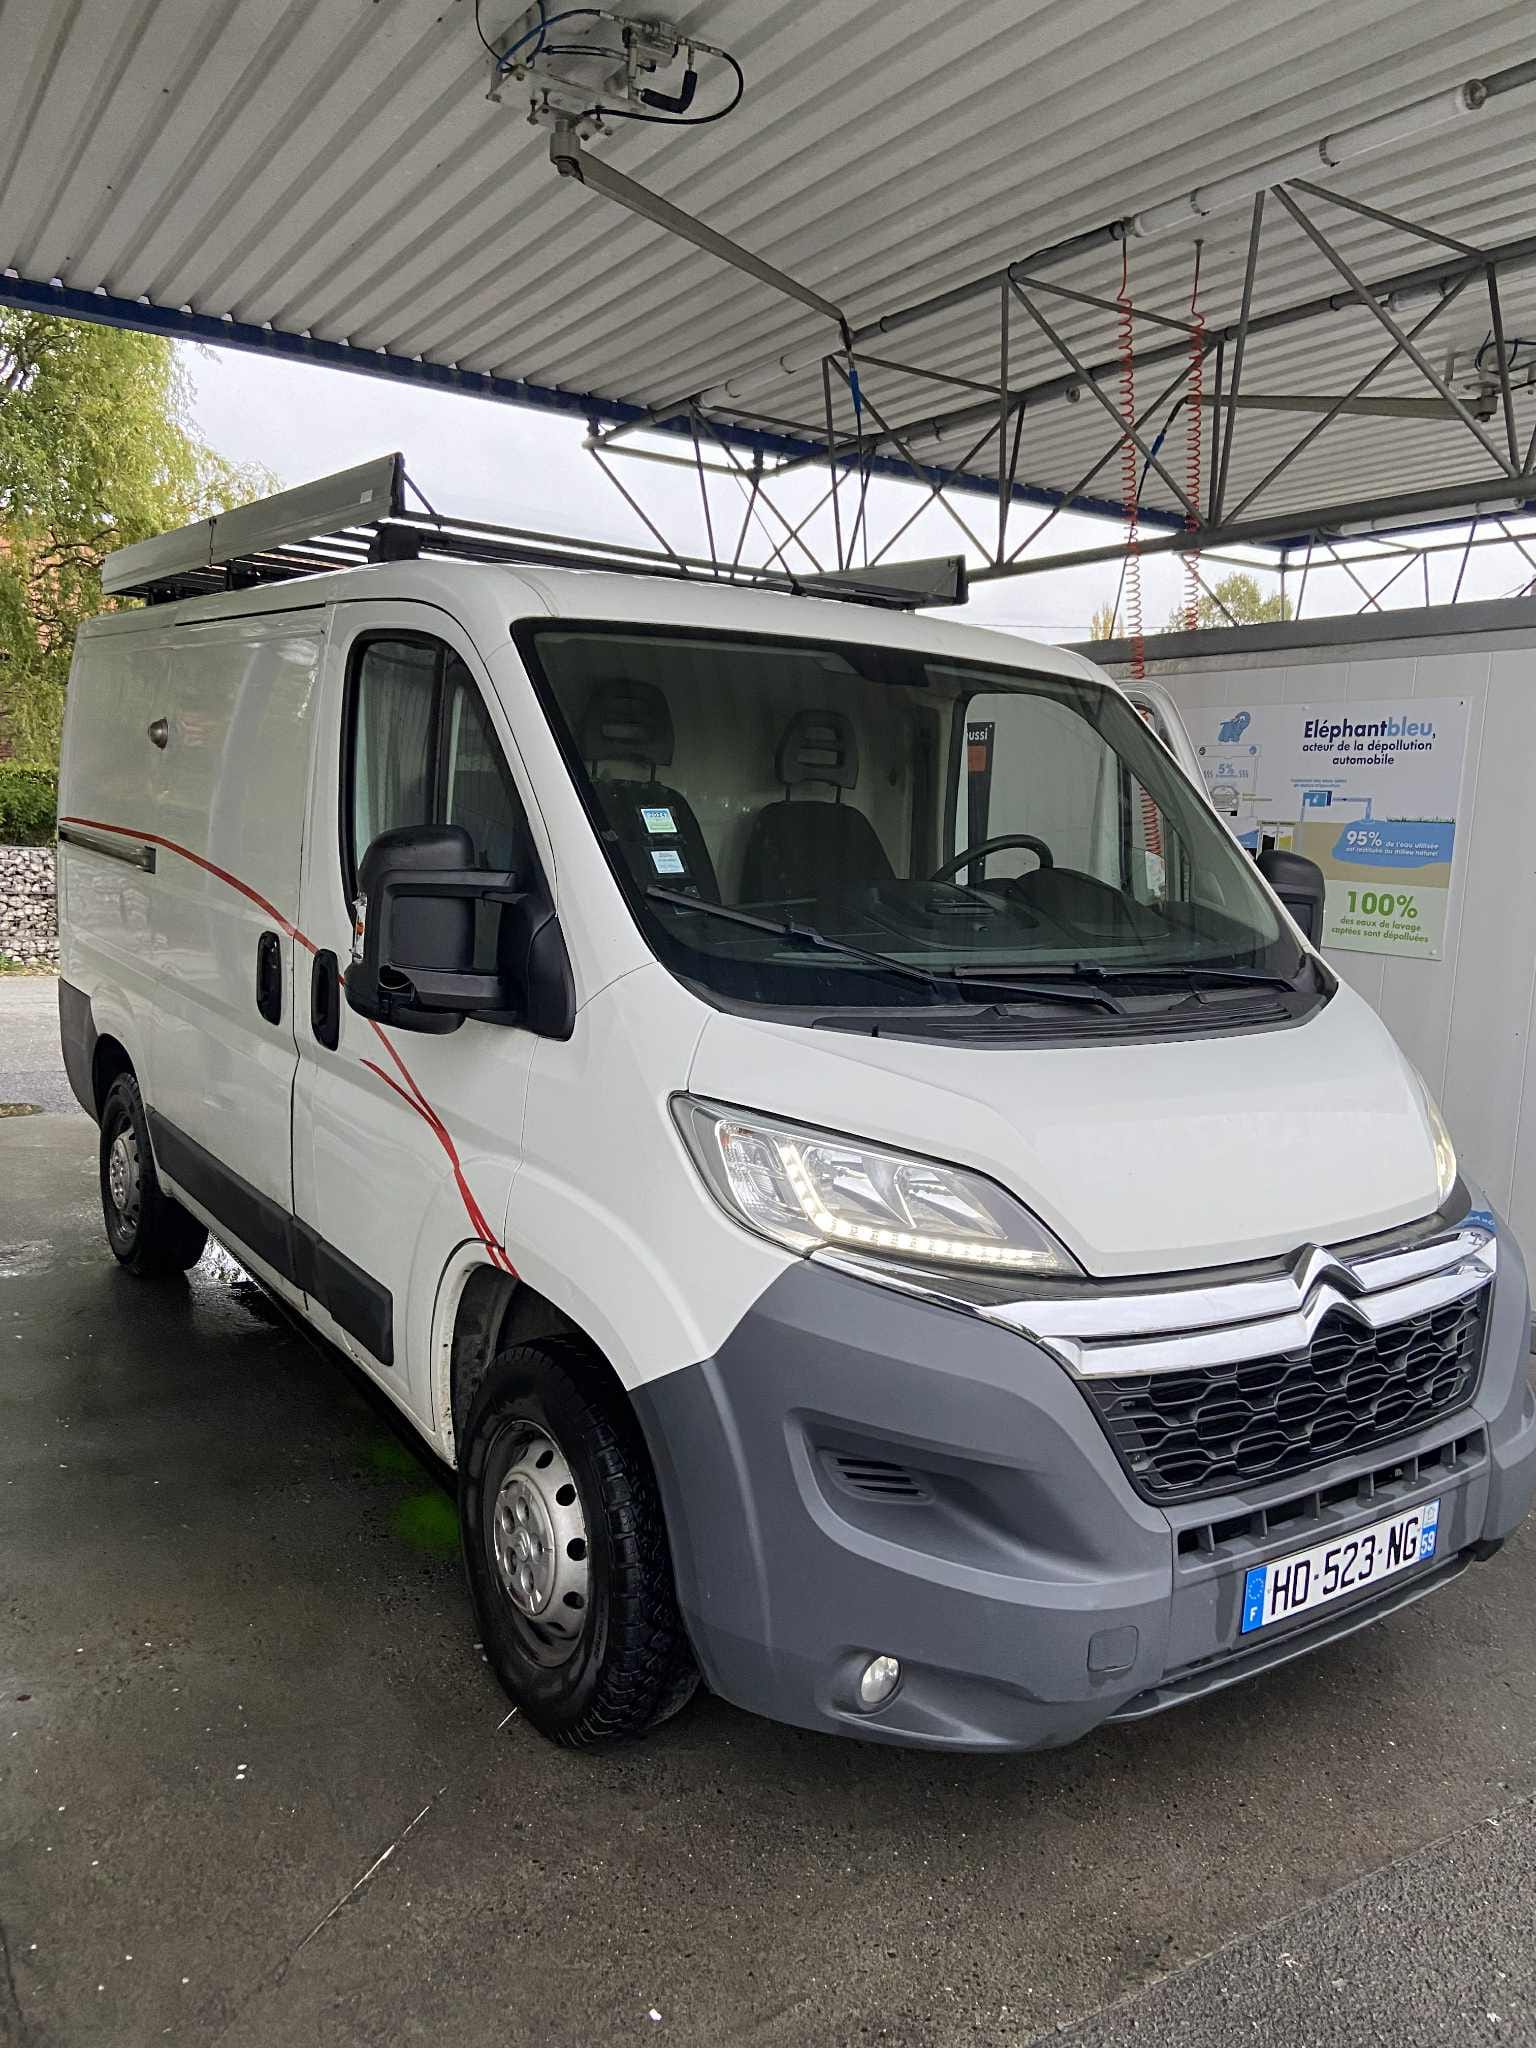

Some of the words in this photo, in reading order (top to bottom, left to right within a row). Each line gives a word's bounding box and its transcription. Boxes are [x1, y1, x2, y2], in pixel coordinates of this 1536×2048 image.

[967, 728, 988, 741] ussi
[1302, 742, 1334, 752] acteur
[1337, 741, 1351, 751] de
[1353, 740, 1364, 751] la
[1367, 739, 1433, 753] dépollution
[1332, 753, 1395, 765] automobile
[1347, 830, 1382, 847] 95%
[1347, 891, 1418, 919] 100%
[1340, 916, 1354, 925] des
[1356, 919, 1377, 928] eaux
[1379, 920, 1390, 929] de
[1392, 920, 1422, 933] lavage
[1363, 930, 1381, 938] sont
[1421, 1531, 1435, 1554] 59
[1271, 1517, 1419, 1616] HD-523-NG
[1249, 1606, 1259, 1622] F
